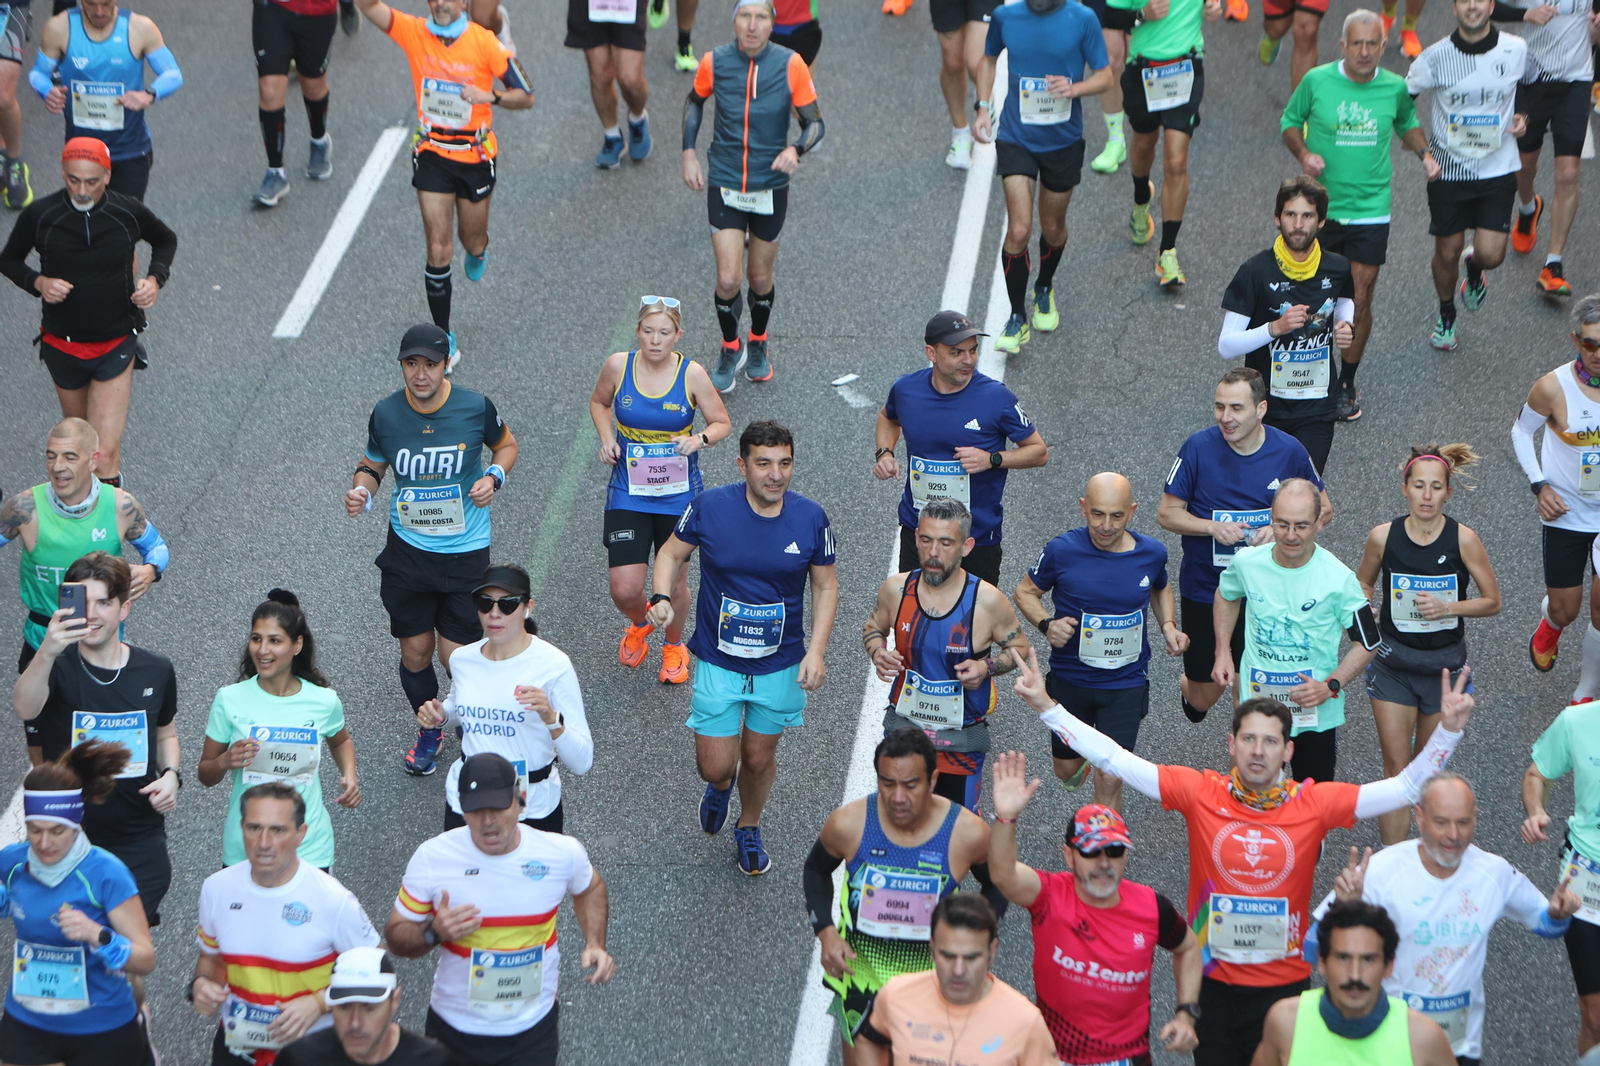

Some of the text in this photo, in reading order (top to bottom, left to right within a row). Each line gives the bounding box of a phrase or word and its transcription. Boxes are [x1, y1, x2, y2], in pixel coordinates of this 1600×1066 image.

[1160, 64, 1187, 77] ZURICH
[89, 86, 117, 95] ZURICH
[439, 83, 464, 93] ZURIC
[1465, 116, 1494, 124] ZURICH
[737, 195, 757, 203] 10276
[1293, 351, 1322, 361] ZURICH
[1292, 369, 1310, 377] 9547
[1286, 379, 1314, 387] GONZALO
[648, 465, 667, 473] 7535
[927, 465, 961, 473] ZURICH
[418, 473, 442, 481] SPORTS
[647, 476, 670, 484] STACEY
[928, 482, 947, 491] 9293
[419, 490, 452, 500] ZURICH
[418, 507, 443, 516] 10985
[1236, 514, 1269, 523] ZURICH
[1413, 580, 1448, 588] ZURICH
[743, 607, 777, 617] ZURICH
[1105, 616, 1138, 627] ZURICH
[738, 624, 764, 636] 11832
[733, 636, 766, 646] NUGONAL
[1104, 637, 1123, 645] 9784
[921, 683, 955, 694] ZURICH
[919, 700, 940, 711] 9716
[910, 710, 948, 723] SATANIX05
[99, 717, 138, 728] ZURICH
[274, 730, 312, 742] ZURICH
[269, 751, 297, 762] 10654
[273, 765, 290, 774] ASH
[889, 878, 930, 891] ZURICH
[886, 899, 910, 909] 6994
[1236, 902, 1277, 913] ZURICH
[877, 912, 914, 923] DOUGLAS
[1233, 924, 1262, 934] 11037
[1435, 921, 1482, 938] IBIZA
[37, 951, 74, 963] ZURICH
[499, 952, 536, 966] ZURICH
[1052, 944, 1086, 974] Los
[38, 972, 60, 984] 6175
[495, 990, 522, 999] JAVIER
[1427, 998, 1465, 1011] ZURICH
